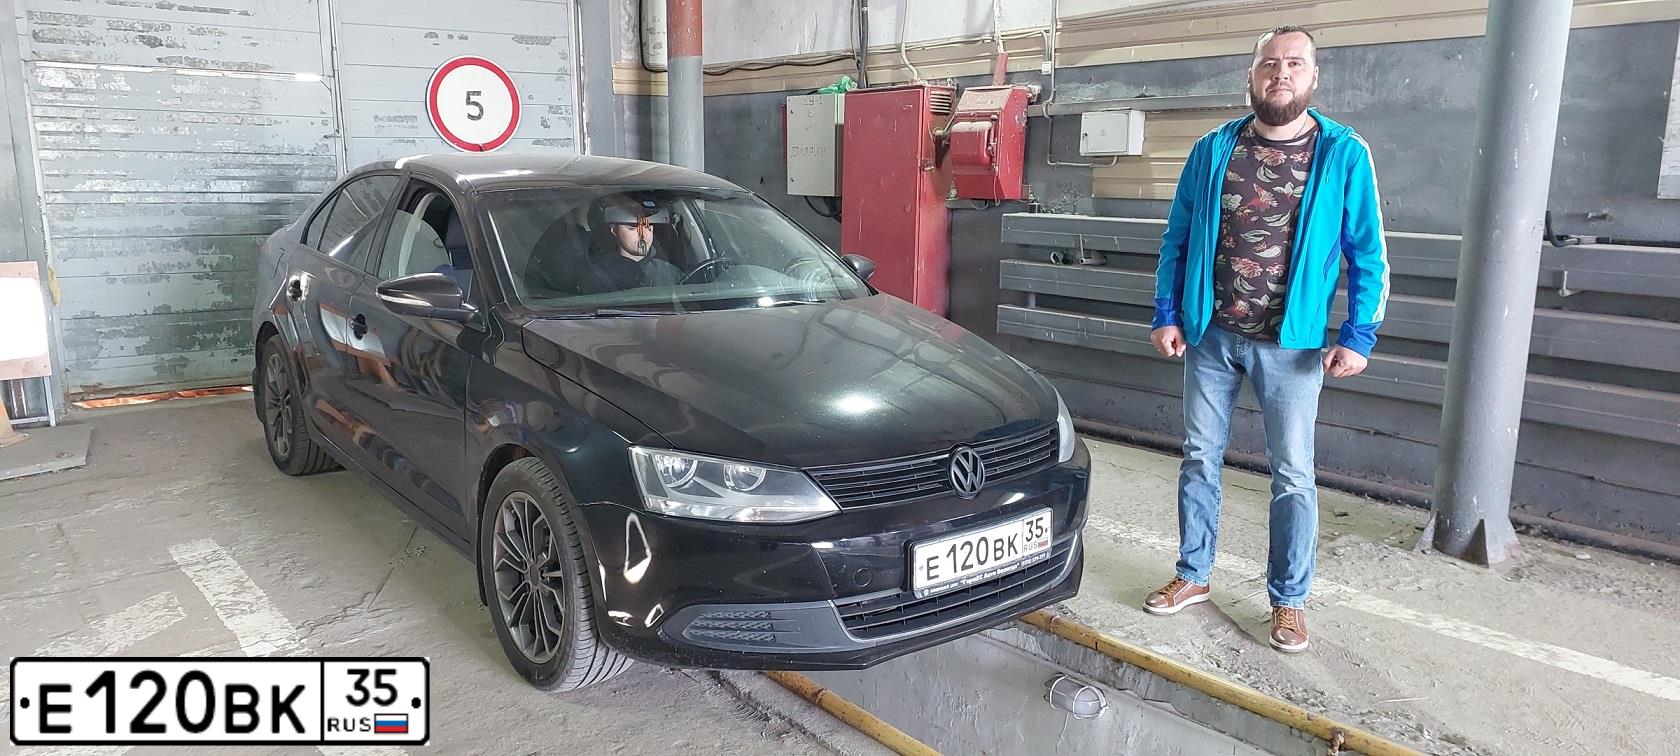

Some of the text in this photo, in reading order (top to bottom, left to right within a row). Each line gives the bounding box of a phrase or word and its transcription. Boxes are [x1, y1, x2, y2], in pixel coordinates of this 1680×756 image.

[465, 90, 484, 121] 5
[1025, 517, 1044, 542] 35
[1023, 542, 1038, 551] RUS
